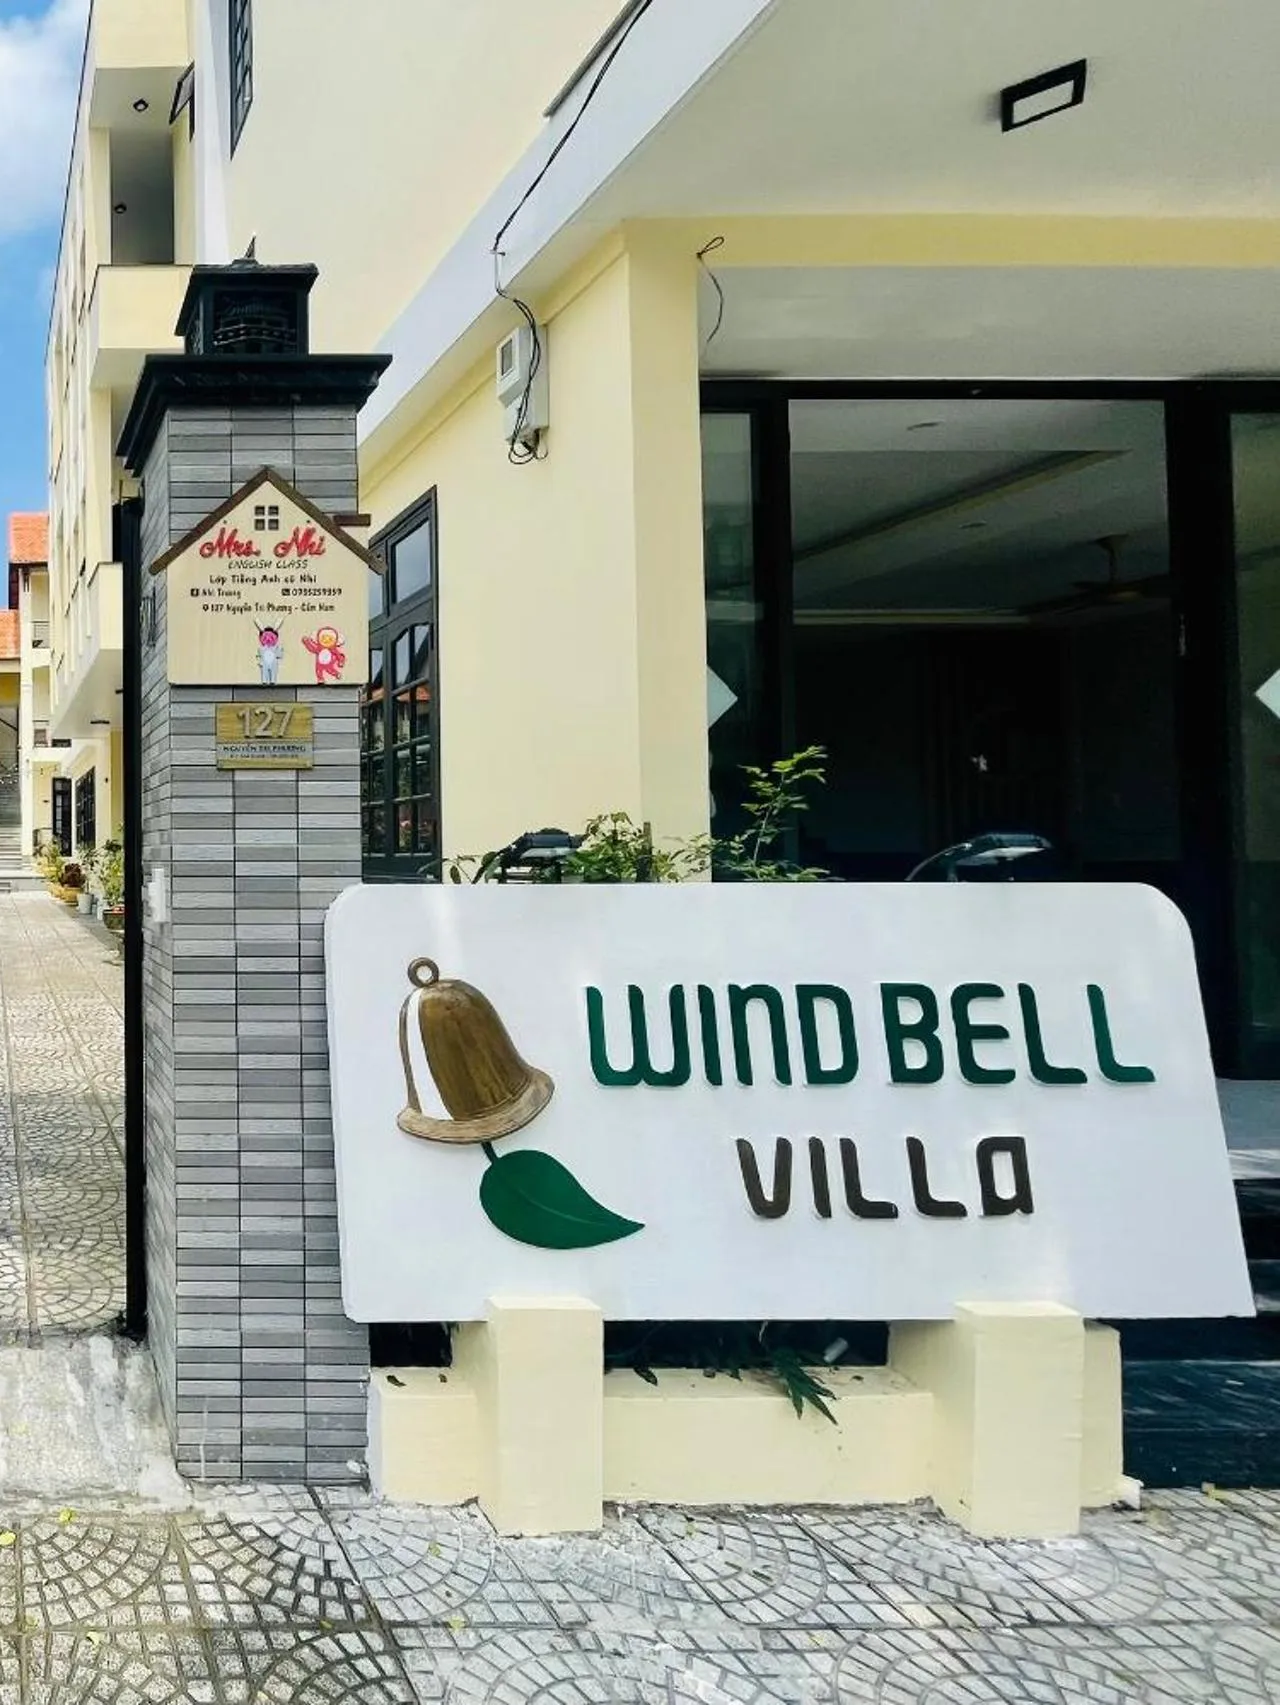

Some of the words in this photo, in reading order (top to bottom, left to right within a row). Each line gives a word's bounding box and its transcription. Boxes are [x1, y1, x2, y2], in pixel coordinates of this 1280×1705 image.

[228, 559, 272, 569] ENGLISH
[276, 559, 308, 569] CLASS
[261, 574, 280, 583] Anh
[237, 705, 294, 738] 127
[880, 981, 1156, 1087] BELL
